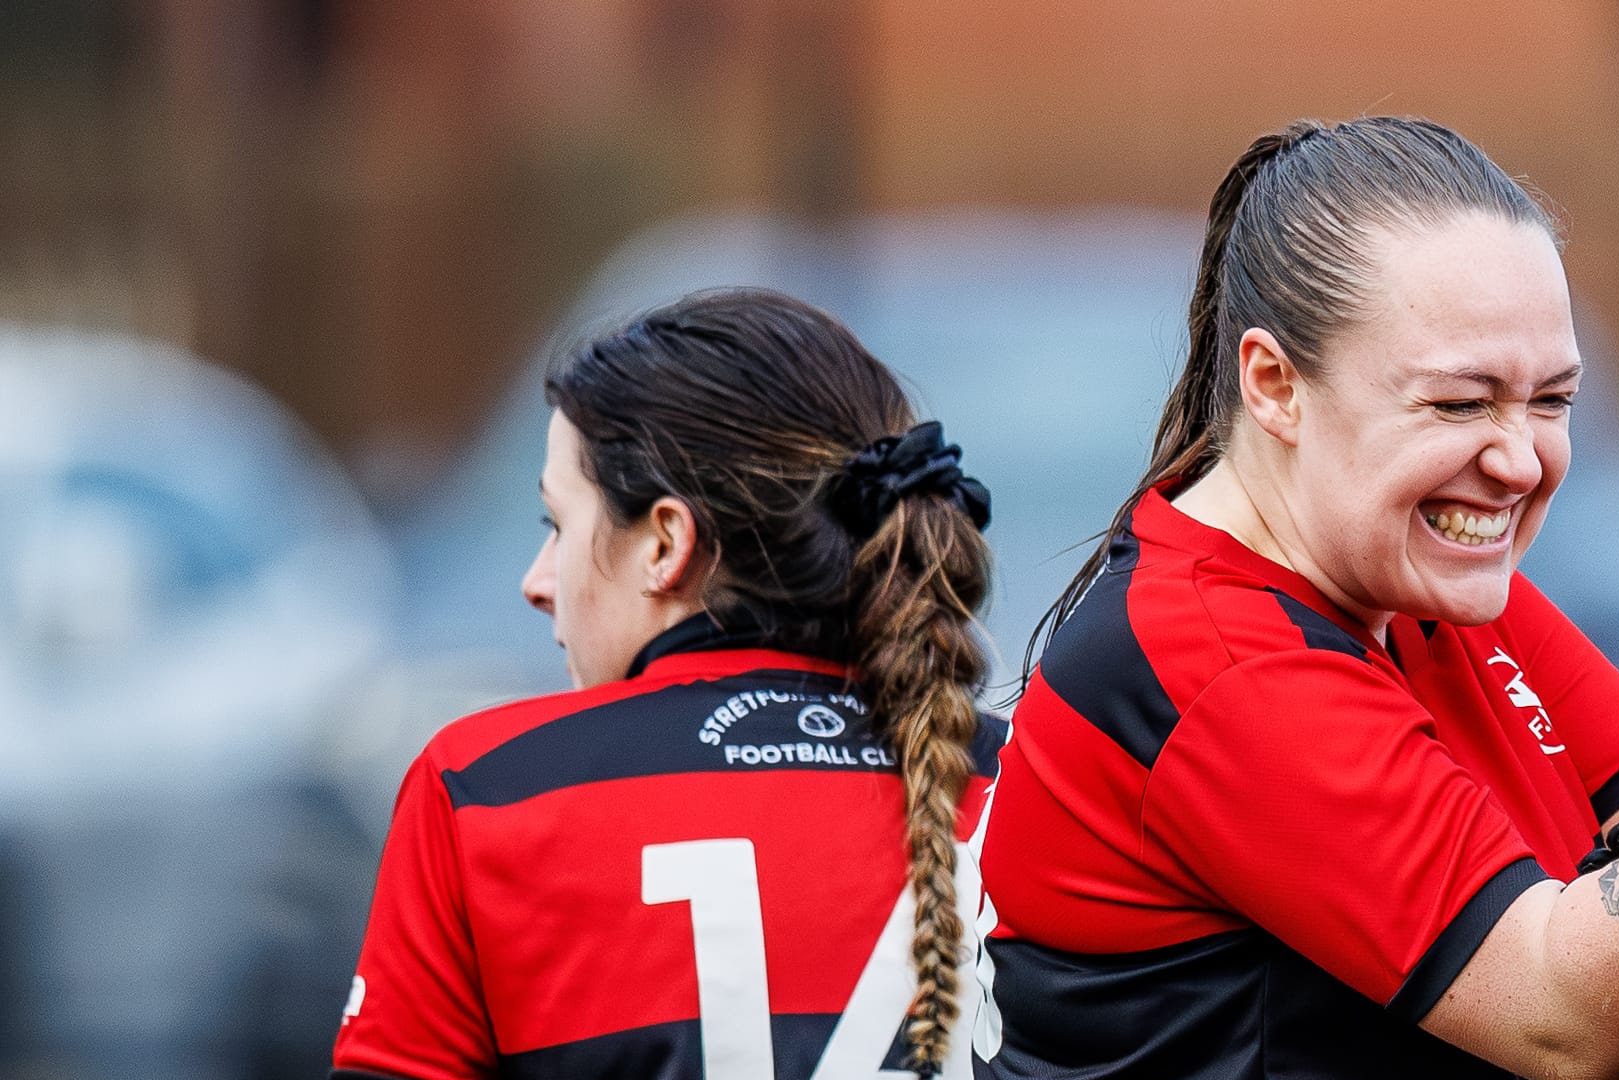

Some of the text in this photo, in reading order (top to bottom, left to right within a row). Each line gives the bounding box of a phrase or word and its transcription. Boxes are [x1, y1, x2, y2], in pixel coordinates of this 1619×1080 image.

[698, 689, 822, 746] STRETFO
[724, 743, 896, 767] FOOTBALL CL
